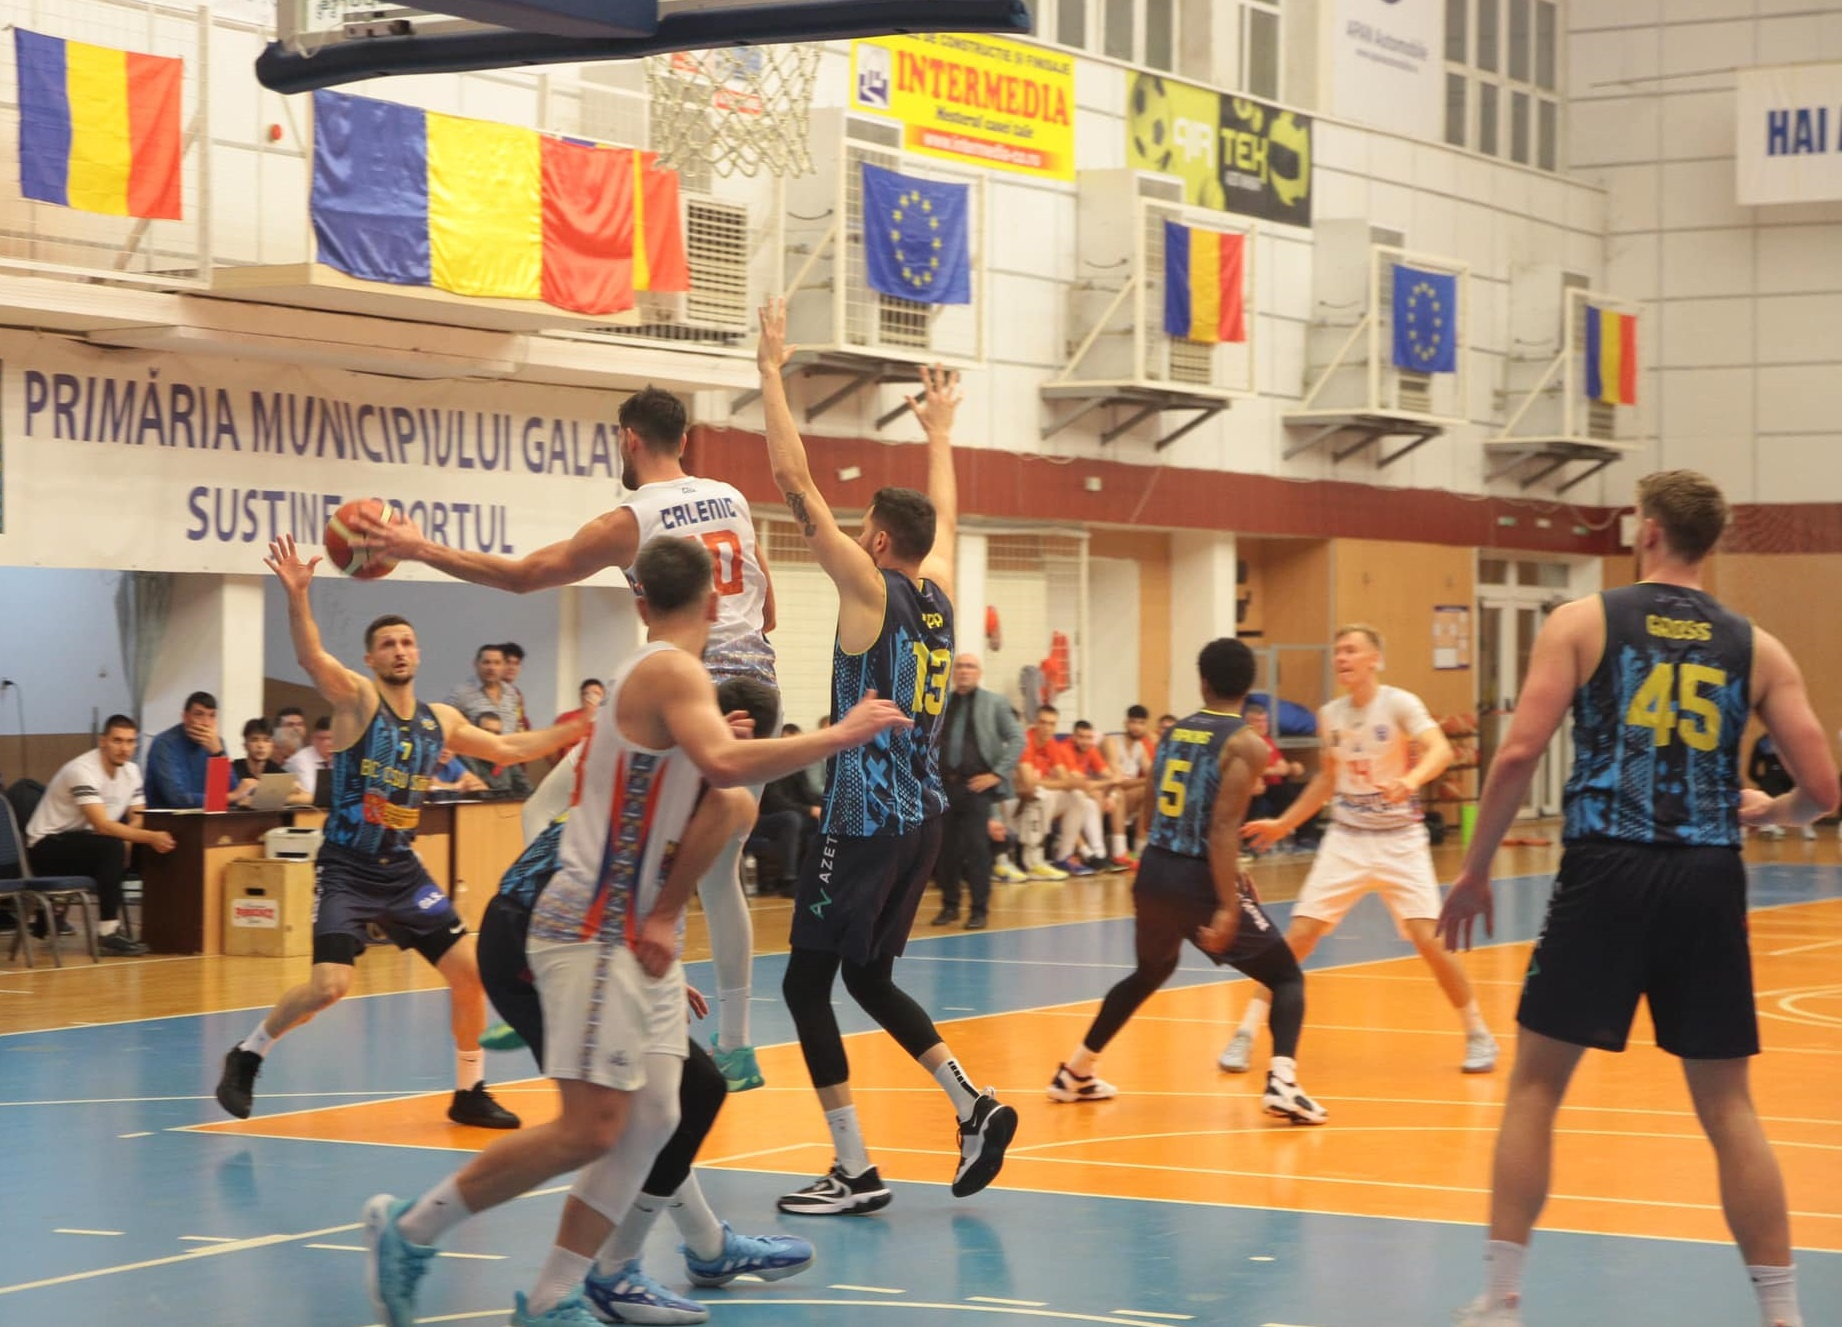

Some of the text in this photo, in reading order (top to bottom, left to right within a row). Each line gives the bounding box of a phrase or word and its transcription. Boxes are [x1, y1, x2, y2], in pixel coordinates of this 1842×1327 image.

[896, 50, 1071, 127] INTERMEDIA
[1766, 105, 1829, 157] HAI
[24, 367, 242, 452] PRIMĂRIA
[250, 390, 512, 472] MUNICIPIULUI
[660, 497, 737, 530] CALENIC
[684, 529, 745, 597] 0
[911, 641, 951, 716] 13
[1625, 662, 1727, 751] 45
[400, 741, 413, 760] 7
[1158, 758, 1193, 818] 5
